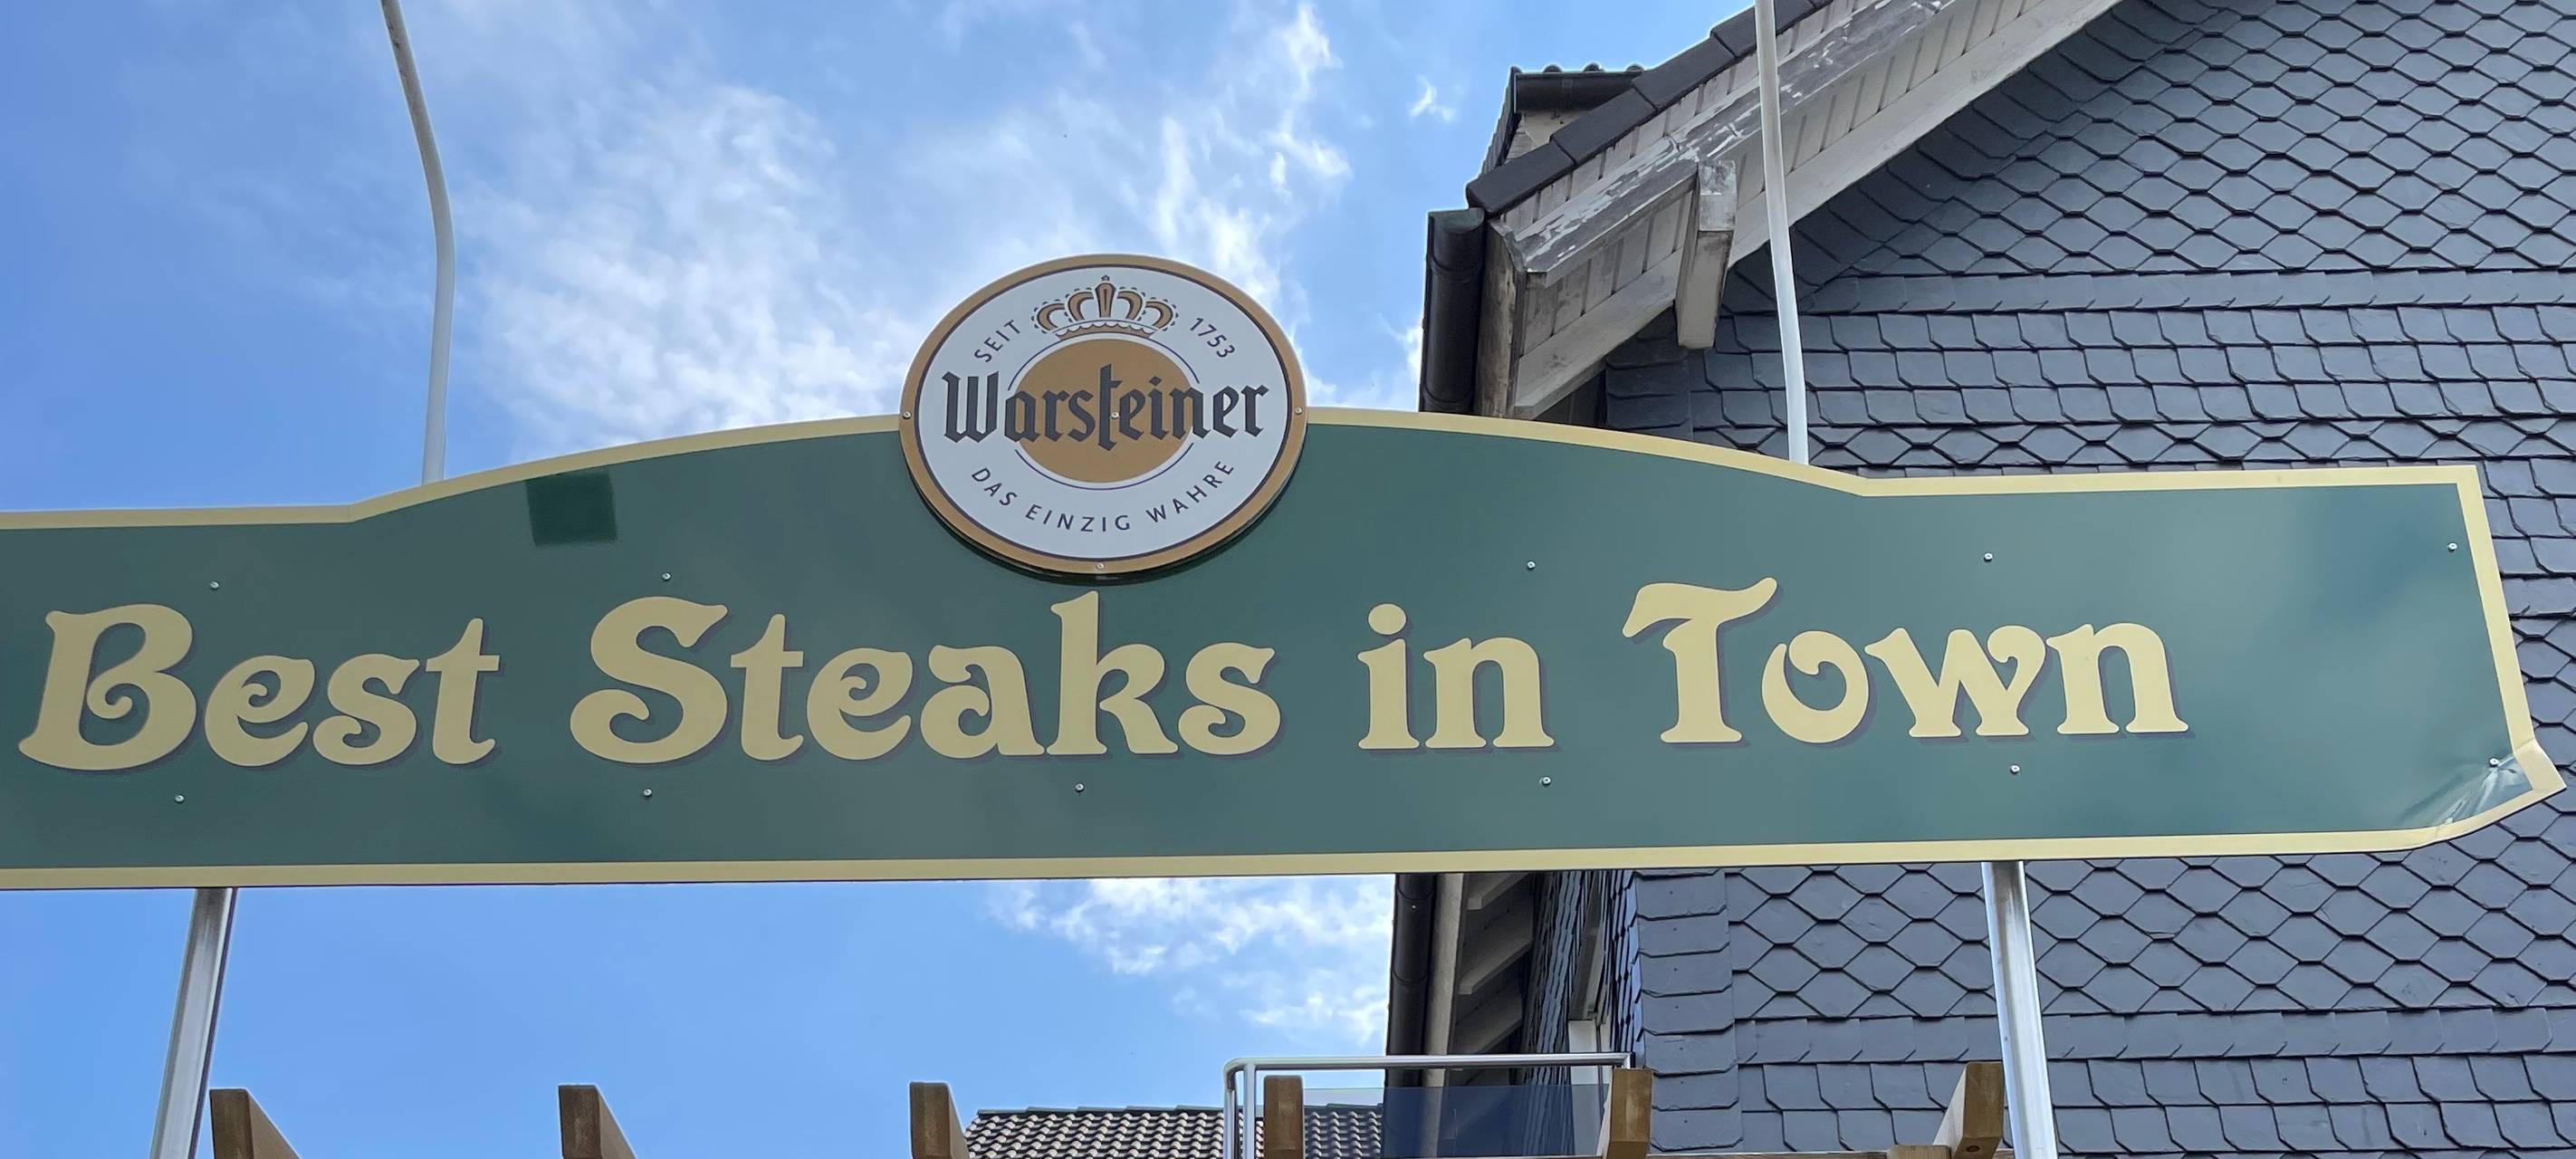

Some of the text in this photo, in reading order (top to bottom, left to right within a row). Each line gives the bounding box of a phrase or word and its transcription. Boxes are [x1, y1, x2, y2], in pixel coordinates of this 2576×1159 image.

[973, 318, 1020, 363] SEIT
[1188, 317, 1236, 359] 1753
[942, 363, 1269, 451] Warsteiner
[971, 460, 1234, 532] DAS EINZIG WAHRE
[18, 577, 2189, 771] Best Steaks in Town
